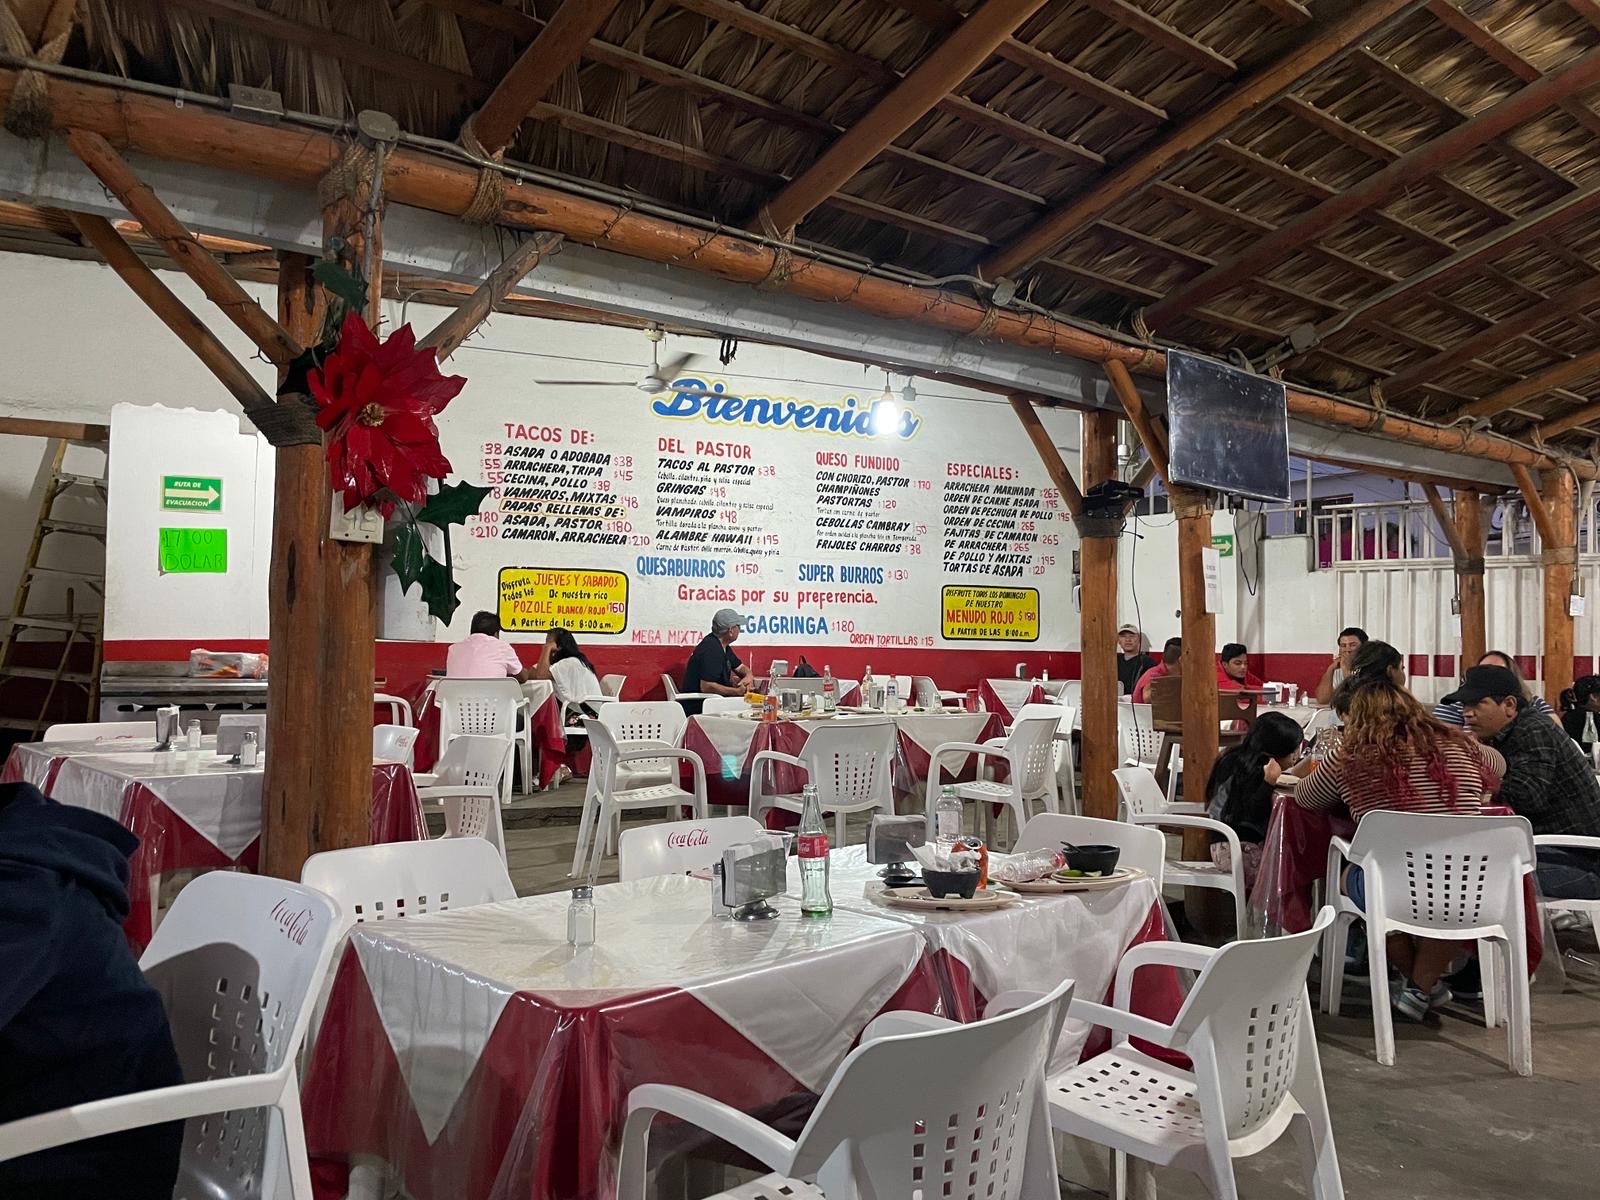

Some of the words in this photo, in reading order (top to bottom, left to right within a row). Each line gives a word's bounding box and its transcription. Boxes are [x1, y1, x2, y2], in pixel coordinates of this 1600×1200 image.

[653, 378, 919, 437] Bienvenids
[504, 423, 562, 443] TACOS
[571, 430, 594, 445] DE:
[658, 438, 685, 454] DEL
[696, 441, 752, 459] PASTOR
[504, 446, 545, 459] ASADA
[550, 450, 558, 460] O
[560, 451, 611, 466] ADOBADA
[614, 456, 633, 467] $38
[816, 451, 847, 467] QUESO
[855, 455, 900, 471] FUNDIDO
[504, 460, 570, 476] ARRACHERA,
[572, 465, 603, 477] TRIPA
[658, 458, 694, 470] TACOS
[697, 462, 710, 472] AL
[714, 463, 756, 476] PASTOR
[551, 477, 588, 489] POLLO
[816, 471, 835, 481] CON
[836, 473, 875, 486] CHORIZO,
[876, 476, 910, 488] PASTOR
[504, 487, 568, 502] VAMPIROS,
[570, 492, 617, 504] MIXTAS
[656, 482, 706, 495] GRINGAS
[816, 483, 880, 496] CHAMPIÑONES
[944, 481, 990, 493] ARRACHERA
[993, 485, 1035, 497] MARINADA
[816, 495, 873, 508] PASTORTAS
[944, 493, 970, 504] ORDEN
[972, 495, 982, 504] DE
[984, 496, 1010, 506] CARNE
[1013, 498, 1040, 508] ASADA
[502, 501, 542, 512] PAPAS
[546, 504, 602, 516] RELLENAS
[604, 507, 624, 517] DE:
[656, 506, 717, 519] VAMPIROS
[720, 511, 737, 524] $48
[943, 505, 970, 515] ORDEN
[971, 506, 981, 516] DE
[981, 507, 1018, 518] PECHUGA
[1020, 509, 1029, 519] DE
[1030, 510, 1053, 520] POLLO
[503, 514, 550, 529] ASADA,
[554, 518, 603, 530] PASTOR
[816, 517, 864, 530] CEBOLLAS
[866, 520, 910, 532] CAMBRAY
[944, 516, 972, 527] ORDEN
[973, 518, 984, 528] DE
[986, 519, 1015, 529] CECINA
[560, 532, 627, 545] ARRACHERA
[656, 530, 708, 542] ALAMBRE
[711, 533, 753, 545] HAWAII
[944, 528, 980, 539] FAJITAS
[984, 530, 995, 540] DE
[997, 531, 1038, 542] CAMARON
[816, 539, 857, 551] FRIJOLES
[860, 542, 902, 553] CHARROS
[944, 539, 956, 549] DE
[957, 540, 1008, 552] ARRACHERA
[165, 553, 222, 570] DOLAR
[944, 551, 956, 560] DE
[958, 552, 985, 562] POLLO
[988, 553, 994, 562] Y
[995, 554, 1032, 565] MIXTAS
[637, 556, 726, 578] QUESABURROS
[798, 564, 835, 582] SUPER
[840, 566, 884, 584] BURROS
[944, 562, 977, 573] TORTAS
[979, 564, 990, 574] DE
[992, 564, 1024, 577] ASADA
[534, 573, 571, 586] JUEVES
[573, 574, 580, 586] Y
[582, 576, 618, 588] SABADOS
[562, 590, 591, 600] nuestro
[594, 590, 608, 600] rico
[678, 584, 736, 602] Gracias
[742, 589, 766, 606] por
[773, 591, 788, 603] su
[973, 590, 988, 598] TODOS
[998, 591, 1026, 600] DOMINGOS
[513, 600, 552, 614] POZOLE
[557, 604, 606, 615] BLANCO/ROJO
[976, 600, 1003, 608] NUESTRO
[511, 618, 516, 626] A
[521, 618, 546, 627] Partir
[550, 618, 558, 627] de
[563, 618, 574, 628] las
[946, 609, 986, 624] MENUDO
[990, 610, 1014, 624] ROJO
[832, 620, 855, 633] $180
[958, 628, 977, 636] PARTIR
[980, 628, 987, 636] DE
[989, 628, 1000, 636] LAS
[632, 629, 660, 644] MEGA
[668, 631, 704, 645] MIXTA
[850, 633, 874, 645] ORDEN
[877, 635, 918, 647] TORTILLAS
